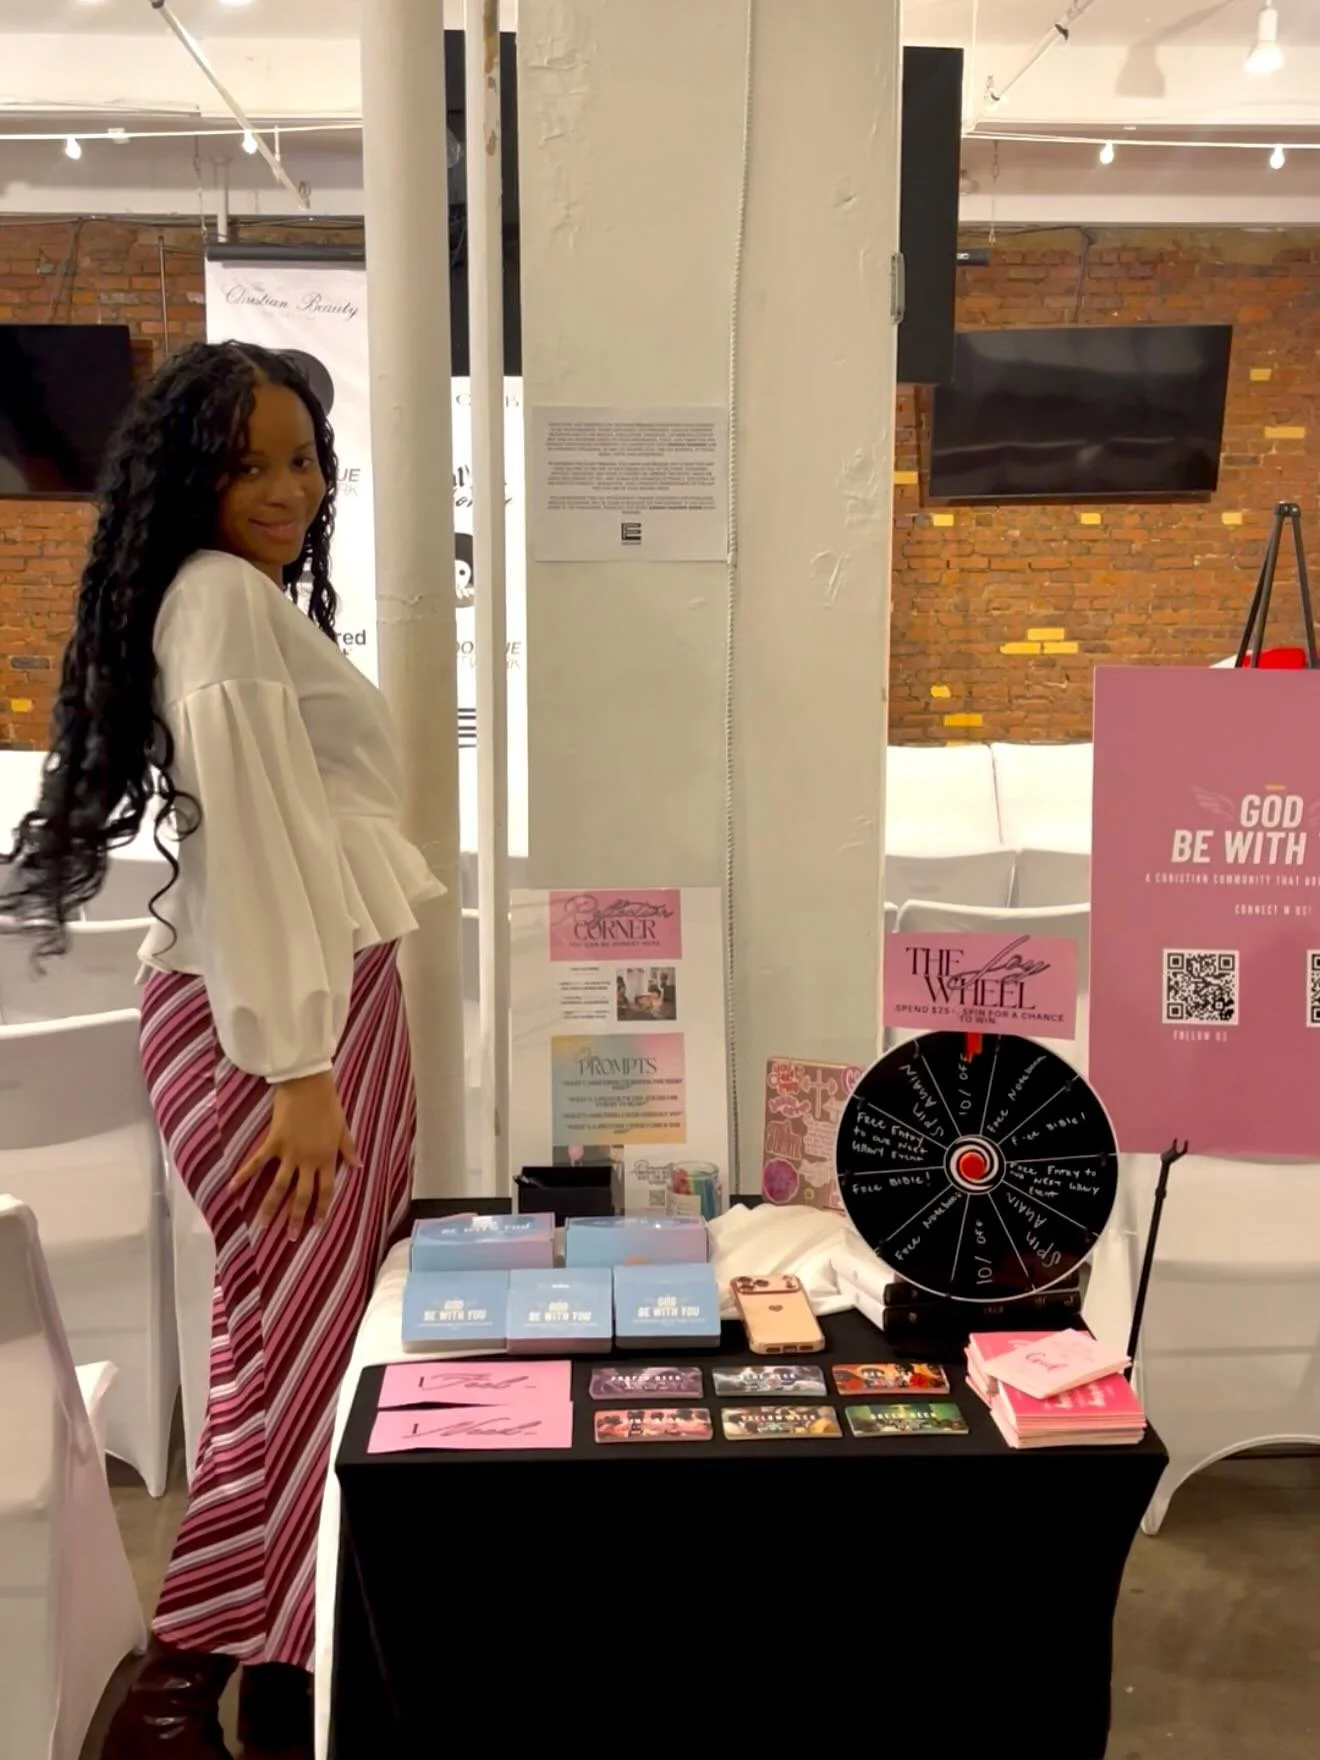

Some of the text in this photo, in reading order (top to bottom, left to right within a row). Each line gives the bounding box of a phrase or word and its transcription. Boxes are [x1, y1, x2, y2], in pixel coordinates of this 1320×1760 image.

[296, 291, 359, 322] Beauty
[1240, 794, 1304, 828] GOD
[1171, 829, 1307, 865] BE WITH
[1155, 872, 1209, 884] CHRISTIAN
[1213, 873, 1271, 885] COMMUNITY
[1276, 875, 1300, 887] THAT
[1234, 903, 1279, 916] CONNECT
[574, 919, 656, 940] CORNER
[906, 946, 964, 977] THE
[924, 976, 1036, 1010] WHEEL
[895, 1004, 928, 1014] SPEND
[962, 1008, 986, 1018] SPIN
[988, 1010, 1009, 1018] FOR
[1012, 1011, 1019, 1019] A
[1021, 1012, 1064, 1022] CHANCE
[960, 1015, 996, 1025] TO WIN
[1173, 1029, 1210, 1041] FOLLOW
[579, 1057, 658, 1075] PROMPTS
[423, 1308, 487, 1321] BE WITH YOU
[528, 1311, 592, 1322] BE WITH YOU
[638, 1305, 700, 1318] BE WITH YOU
